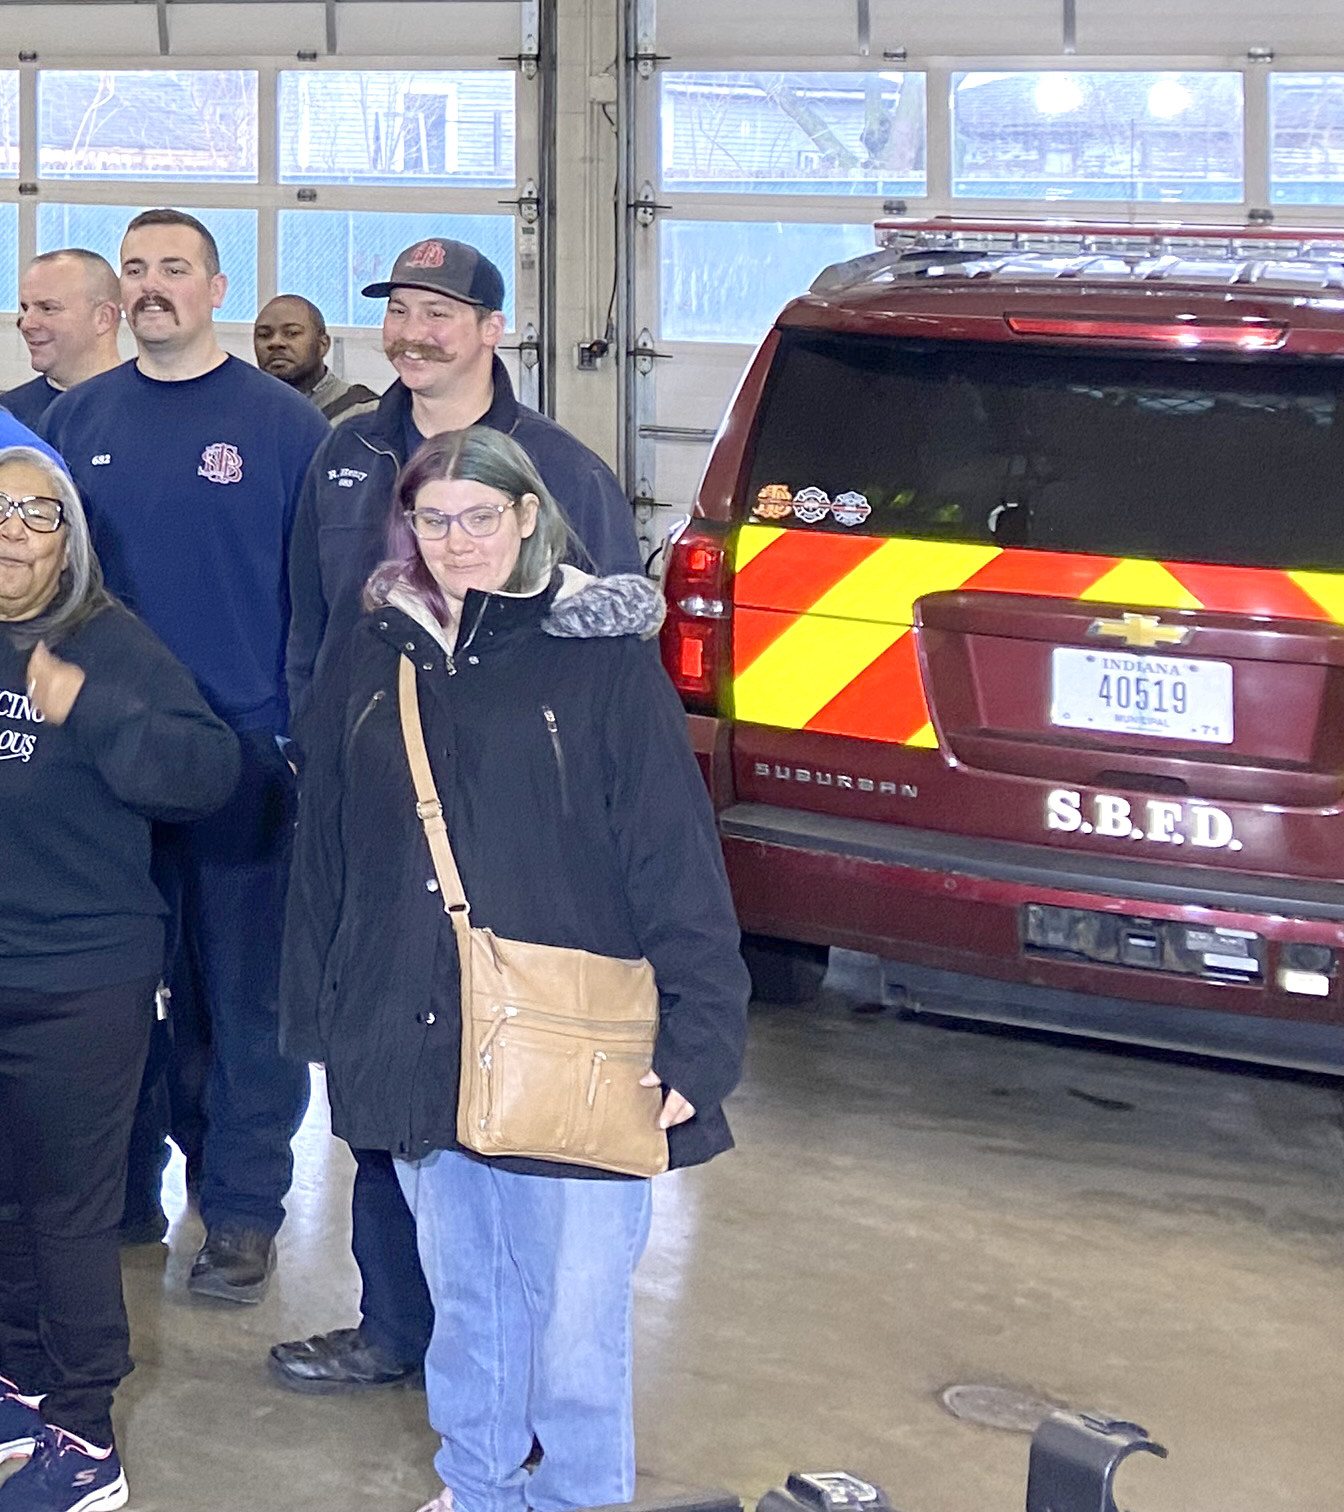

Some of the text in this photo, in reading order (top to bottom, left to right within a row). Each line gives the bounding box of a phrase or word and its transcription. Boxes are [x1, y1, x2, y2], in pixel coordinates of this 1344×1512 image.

[1102, 658, 1181, 676] INDIANA
[1098, 674, 1188, 715] 40519
[1114, 714, 1171, 728] MUNICIPAL
[1200, 725, 1220, 736] 71
[754, 762, 919, 799] SUBURBAN
[1046, 788, 1243, 852] S.B.F.D.
